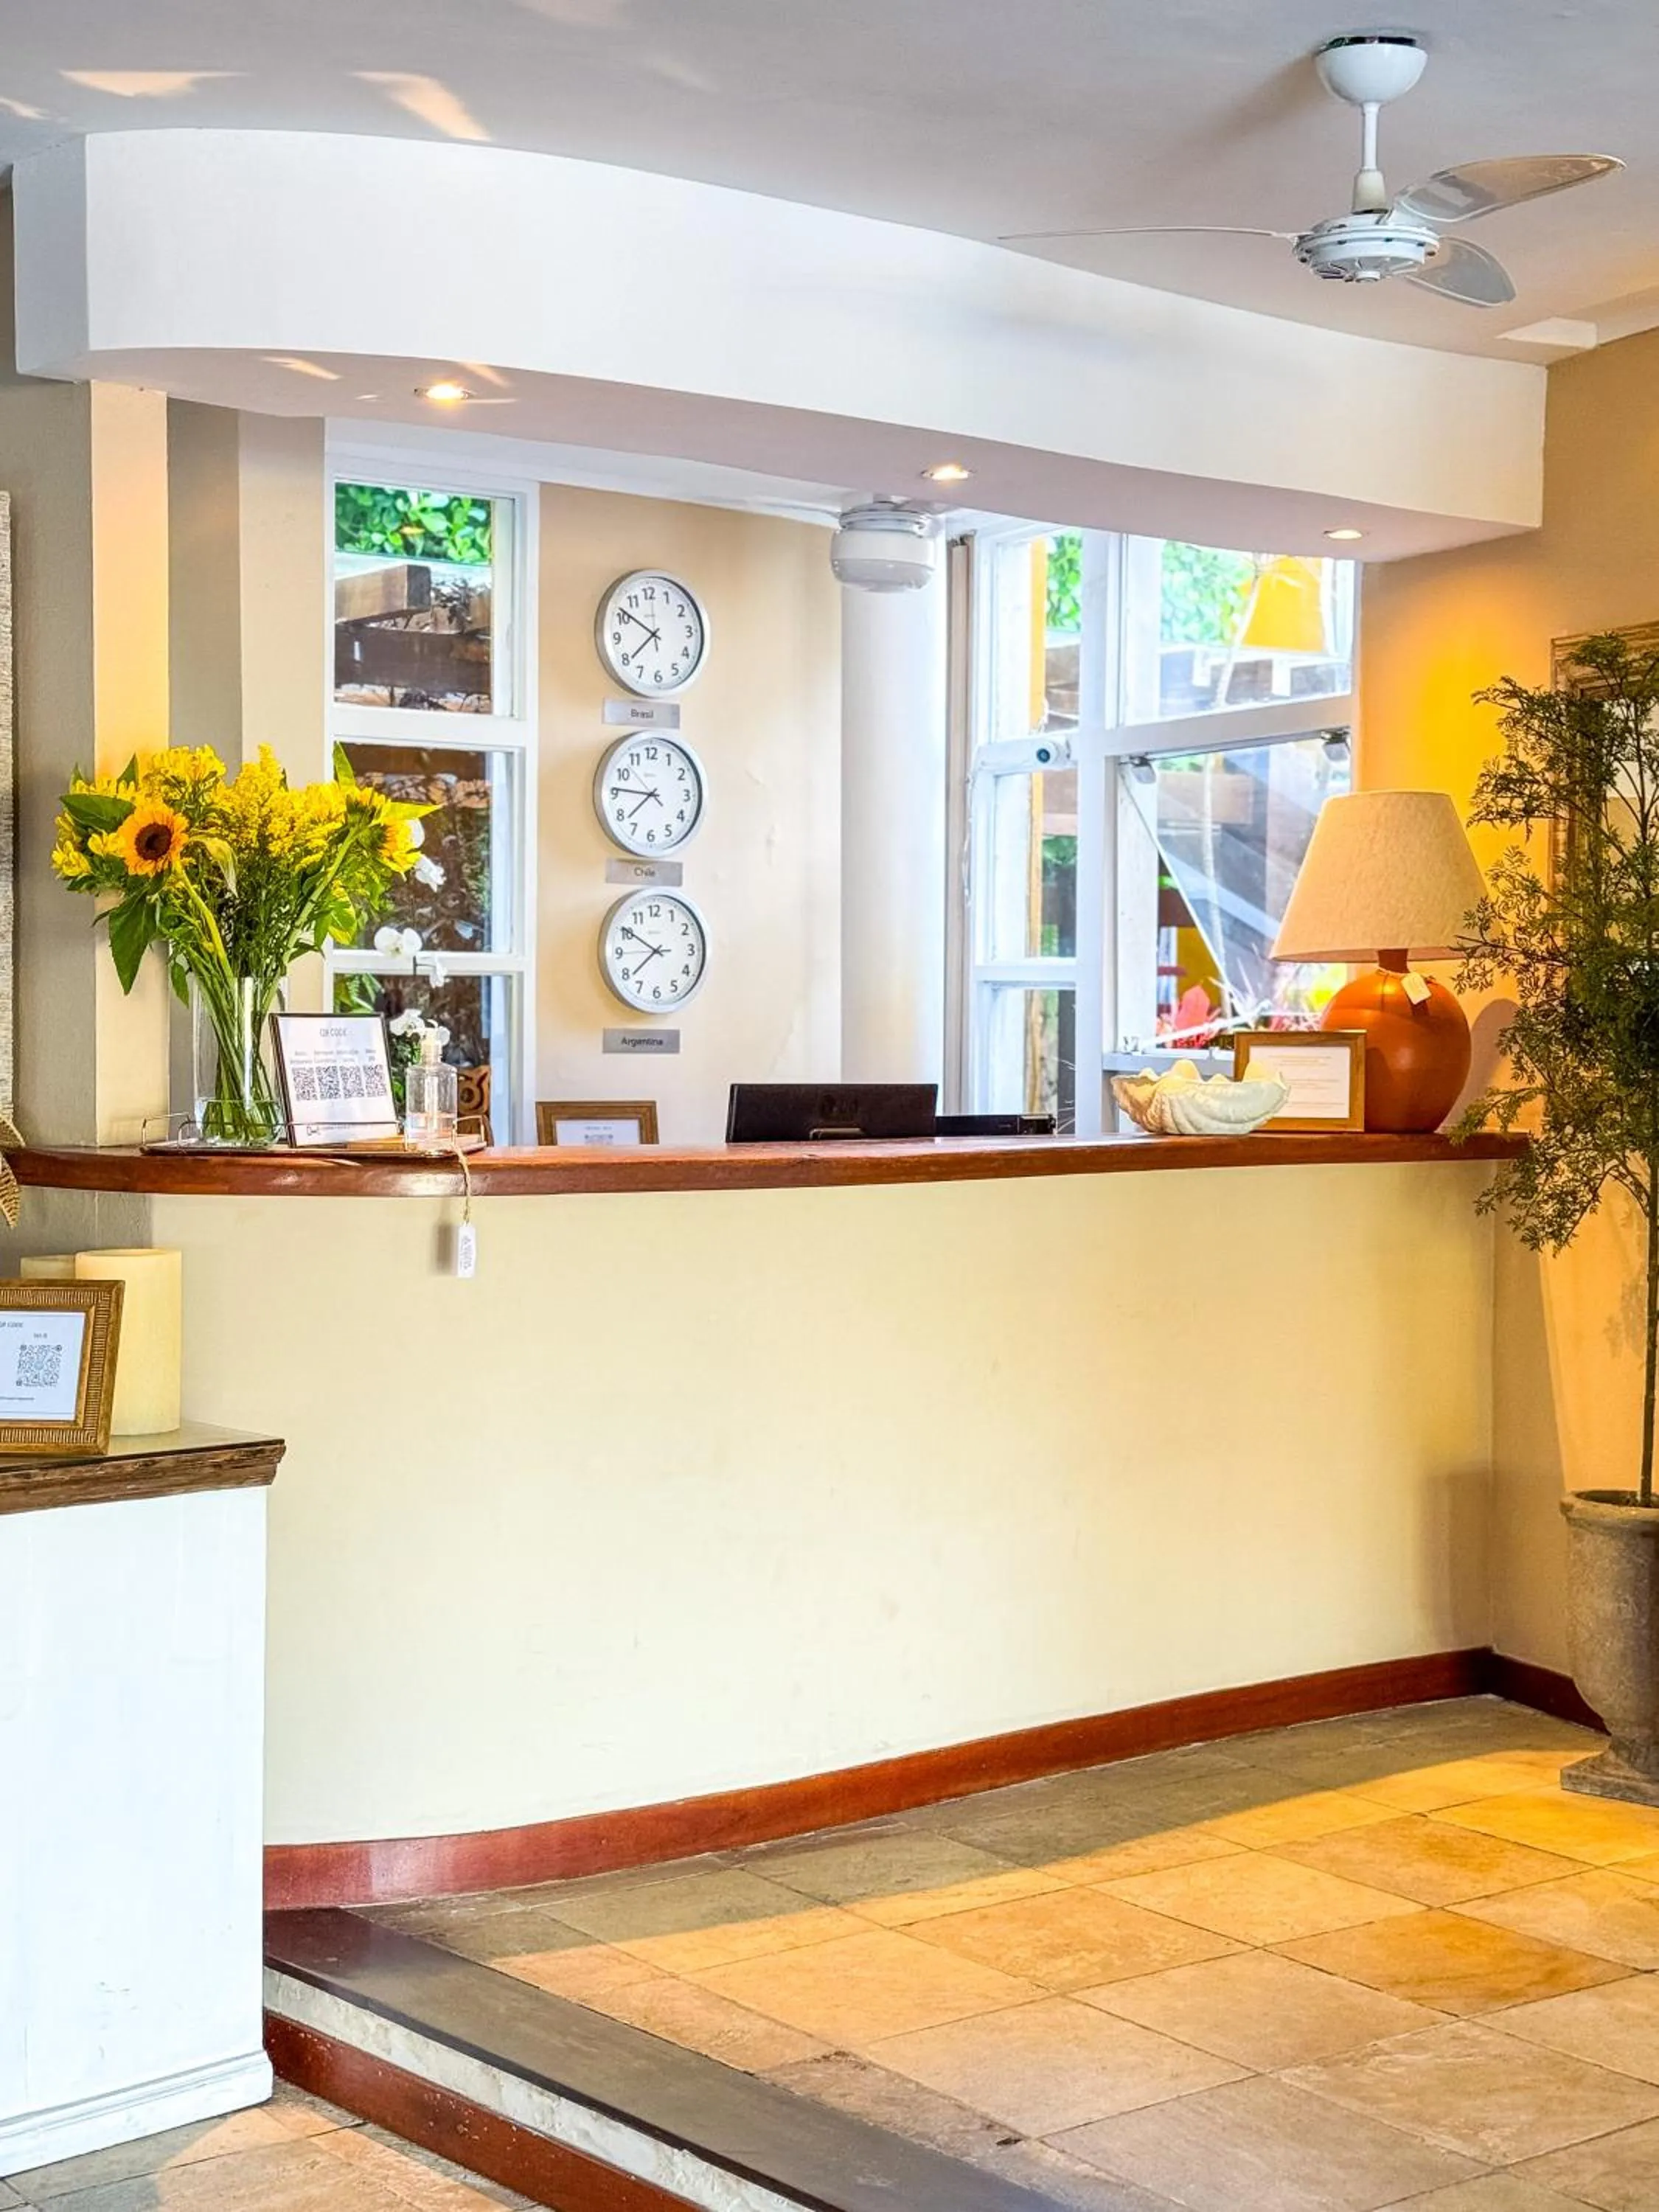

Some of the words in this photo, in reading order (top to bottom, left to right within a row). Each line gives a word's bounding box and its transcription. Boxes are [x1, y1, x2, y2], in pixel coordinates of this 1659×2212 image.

[642, 586, 655, 600] 12
[663, 591, 669, 605] 1
[627, 595, 639, 608] 11
[616, 611, 630, 625] 10
[677, 605, 686, 618] 2
[613, 632, 622, 645] 9
[685, 625, 693, 639] 3
[681, 646, 689, 659] 4
[621, 653, 630, 667] 8
[636, 665, 644, 679] 7
[671, 663, 679, 676] 5
[654, 670, 663, 684] 6
[630, 709, 654, 719] Brasil
[629, 753, 641, 766] 11
[644, 747, 658, 760] 12
[666, 753, 672, 766] 1
[616, 768, 630, 782] 10
[677, 768, 686, 781] 2
[611, 787, 619, 800] 9
[683, 789, 691, 802] 3
[616, 808, 625, 822] 8
[676, 809, 685, 822] 4
[629, 823, 638, 836] 7
[664, 824, 672, 838] 5
[647, 830, 655, 843] 6
[634, 867, 655, 877] Chile
[633, 911, 644, 925] 11
[648, 905, 661, 918] 12
[668, 910, 675, 922] 1
[621, 927, 634, 940] 10
[681, 923, 689, 936] 2
[615, 947, 623, 960] 9
[688, 943, 695, 956] 3
[622, 968, 630, 981] 8
[682, 964, 690, 977] 4
[635, 981, 644, 994] 7
[653, 986, 661, 999] 6
[670, 980, 678, 993] 5
[621, 1037, 663, 1047] Argentina
